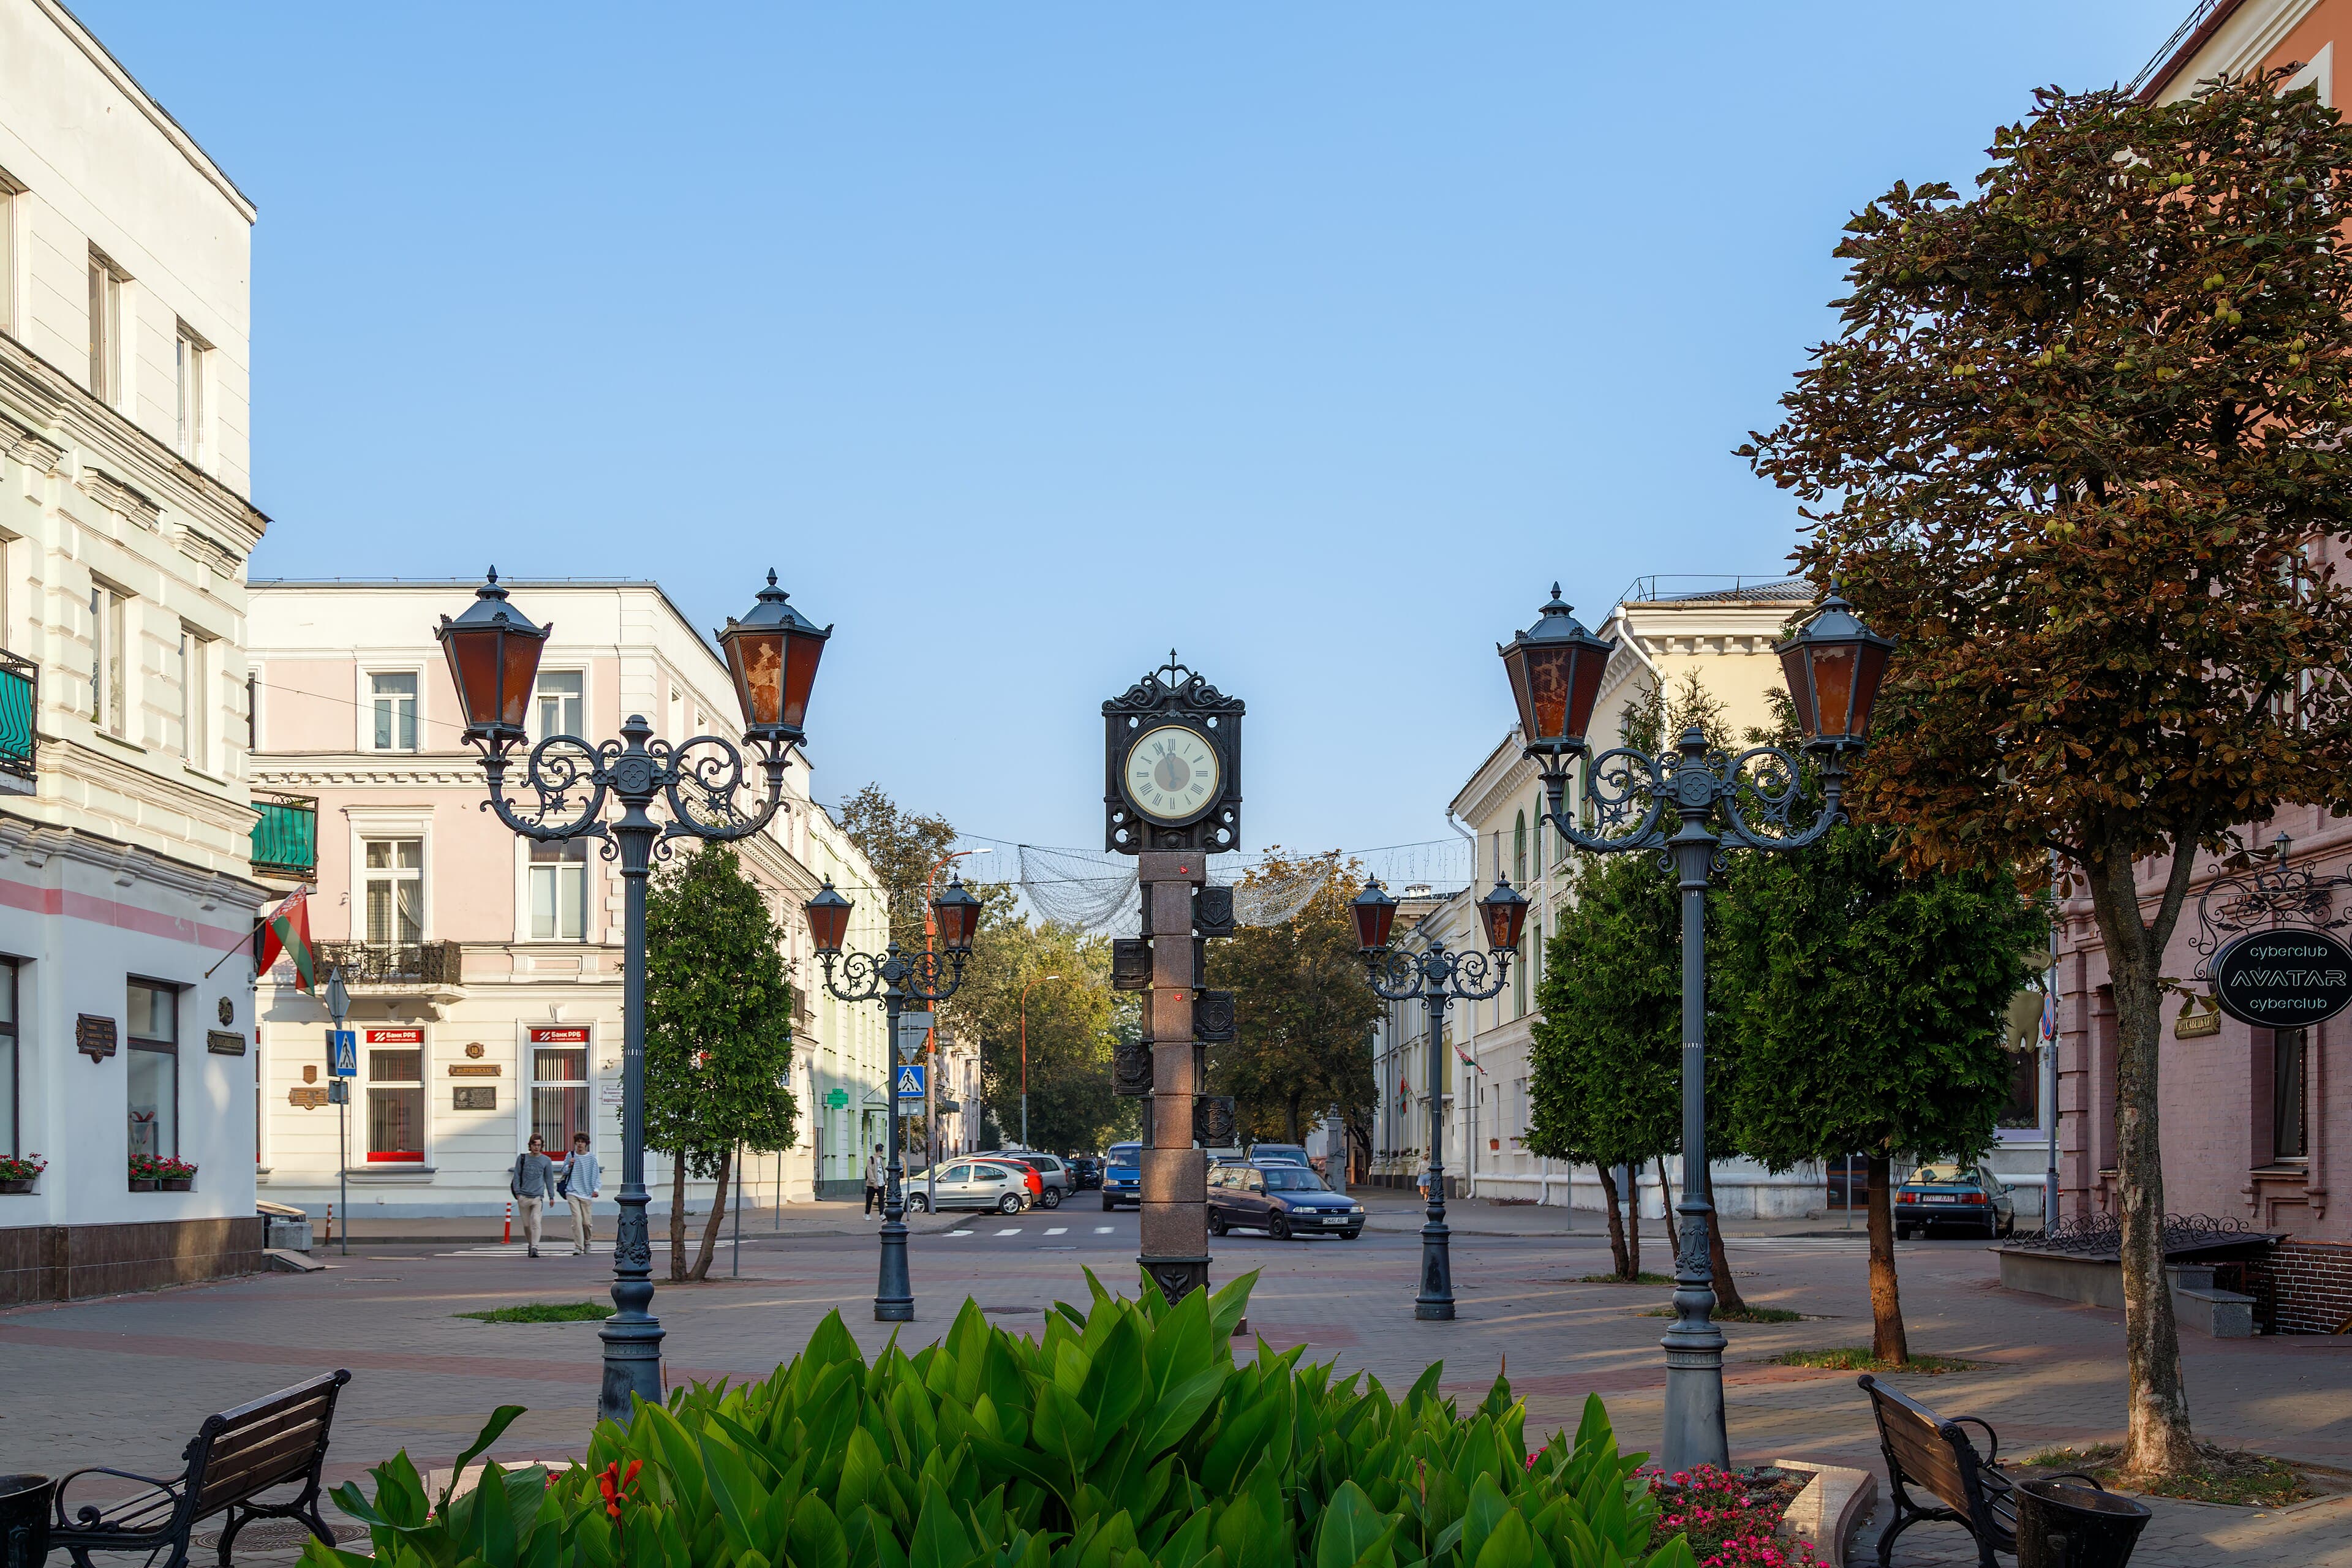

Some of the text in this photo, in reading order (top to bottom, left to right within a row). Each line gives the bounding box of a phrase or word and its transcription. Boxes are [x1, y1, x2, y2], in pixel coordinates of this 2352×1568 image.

[1167, 738, 1176, 752] XII
[1183, 743, 1191, 755] I
[2250, 946, 2328, 960] cyberclub
[2230, 970, 2346, 987] AVATAR
[2250, 998, 2328, 1012] cyberclub
